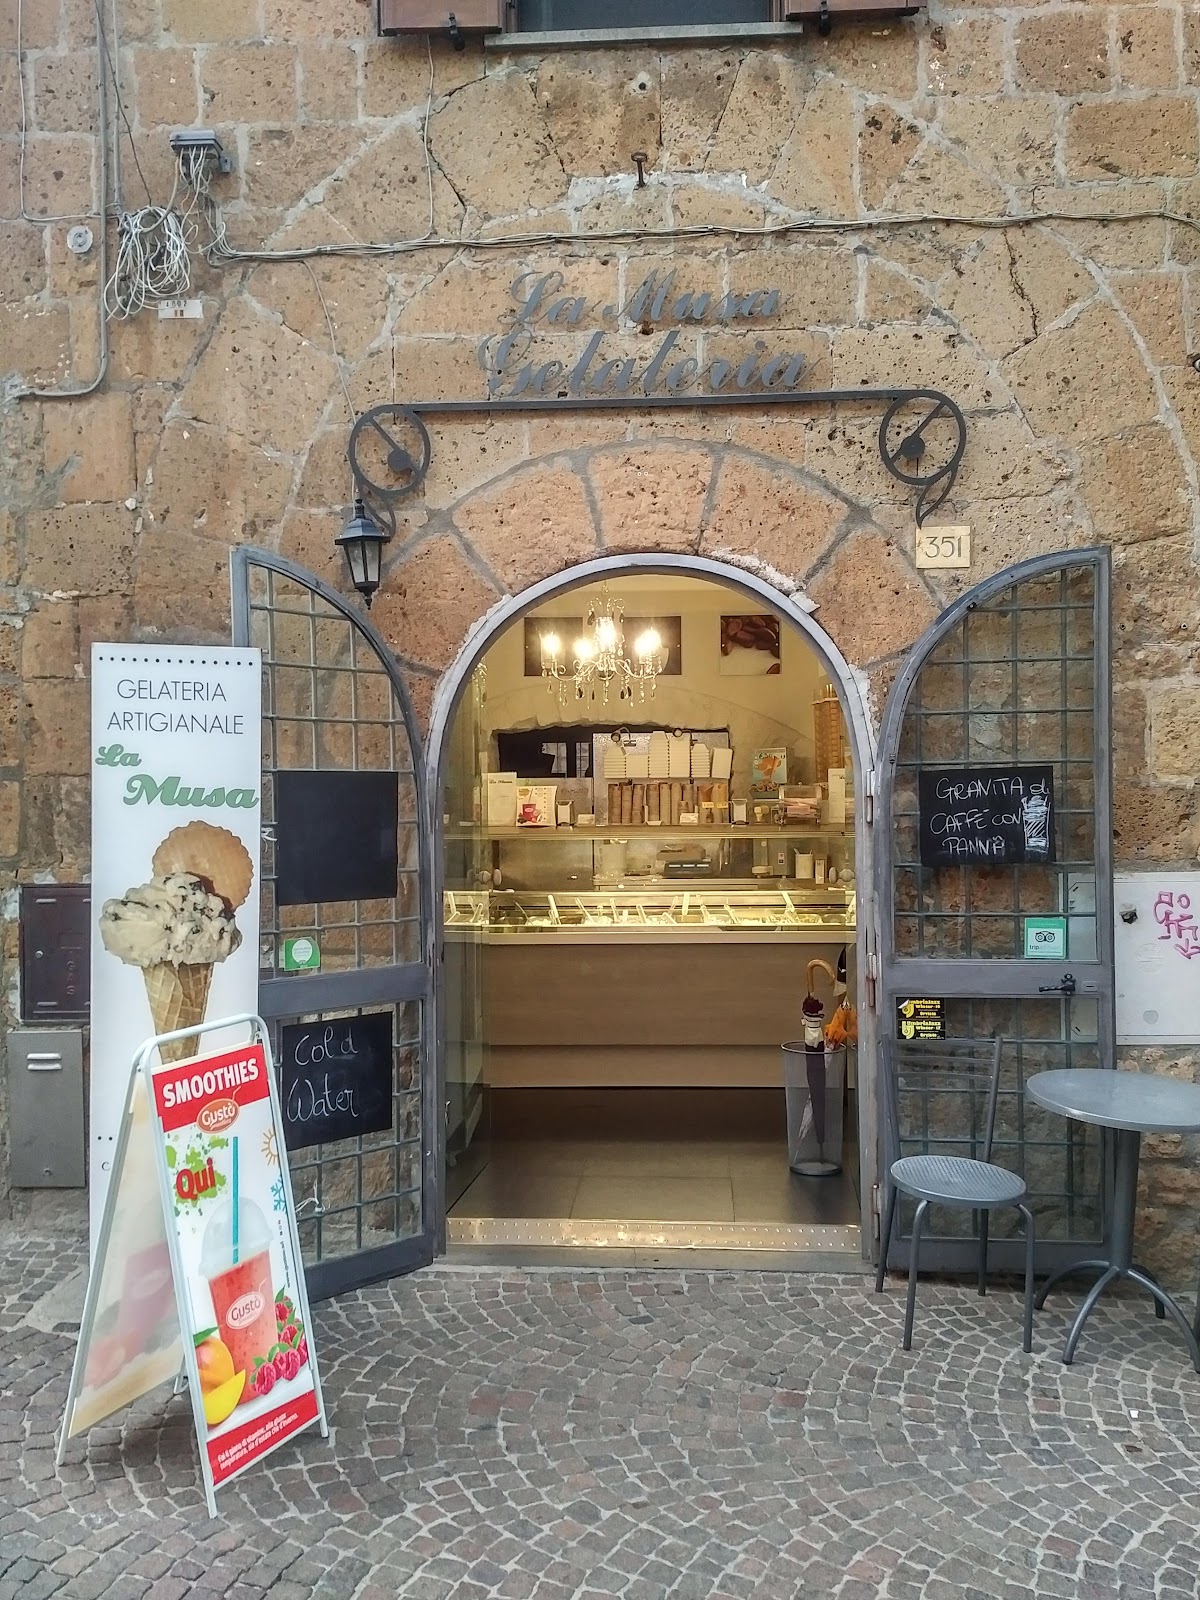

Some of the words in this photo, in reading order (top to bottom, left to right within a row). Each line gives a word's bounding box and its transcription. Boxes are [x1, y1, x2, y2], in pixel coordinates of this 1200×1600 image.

[497, 269, 602, 325] La
[602, 267, 796, 322] Musa
[477, 328, 823, 396] Gelateria
[925, 536, 962, 558] 351
[116, 679, 227, 702] GELATERIA
[107, 712, 244, 735] ARTIGIANALE
[95, 743, 142, 767] La
[123, 773, 260, 809] Musa
[936, 776, 1024, 804] GRANITA
[295, 1026, 359, 1065] Cold
[162, 1057, 259, 1108] SMOOTHIES
[287, 1073, 359, 1122] Water
[201, 1101, 236, 1127] Gustò
[176, 1157, 216, 1200] Qui
[231, 1295, 261, 1321] Gustò
